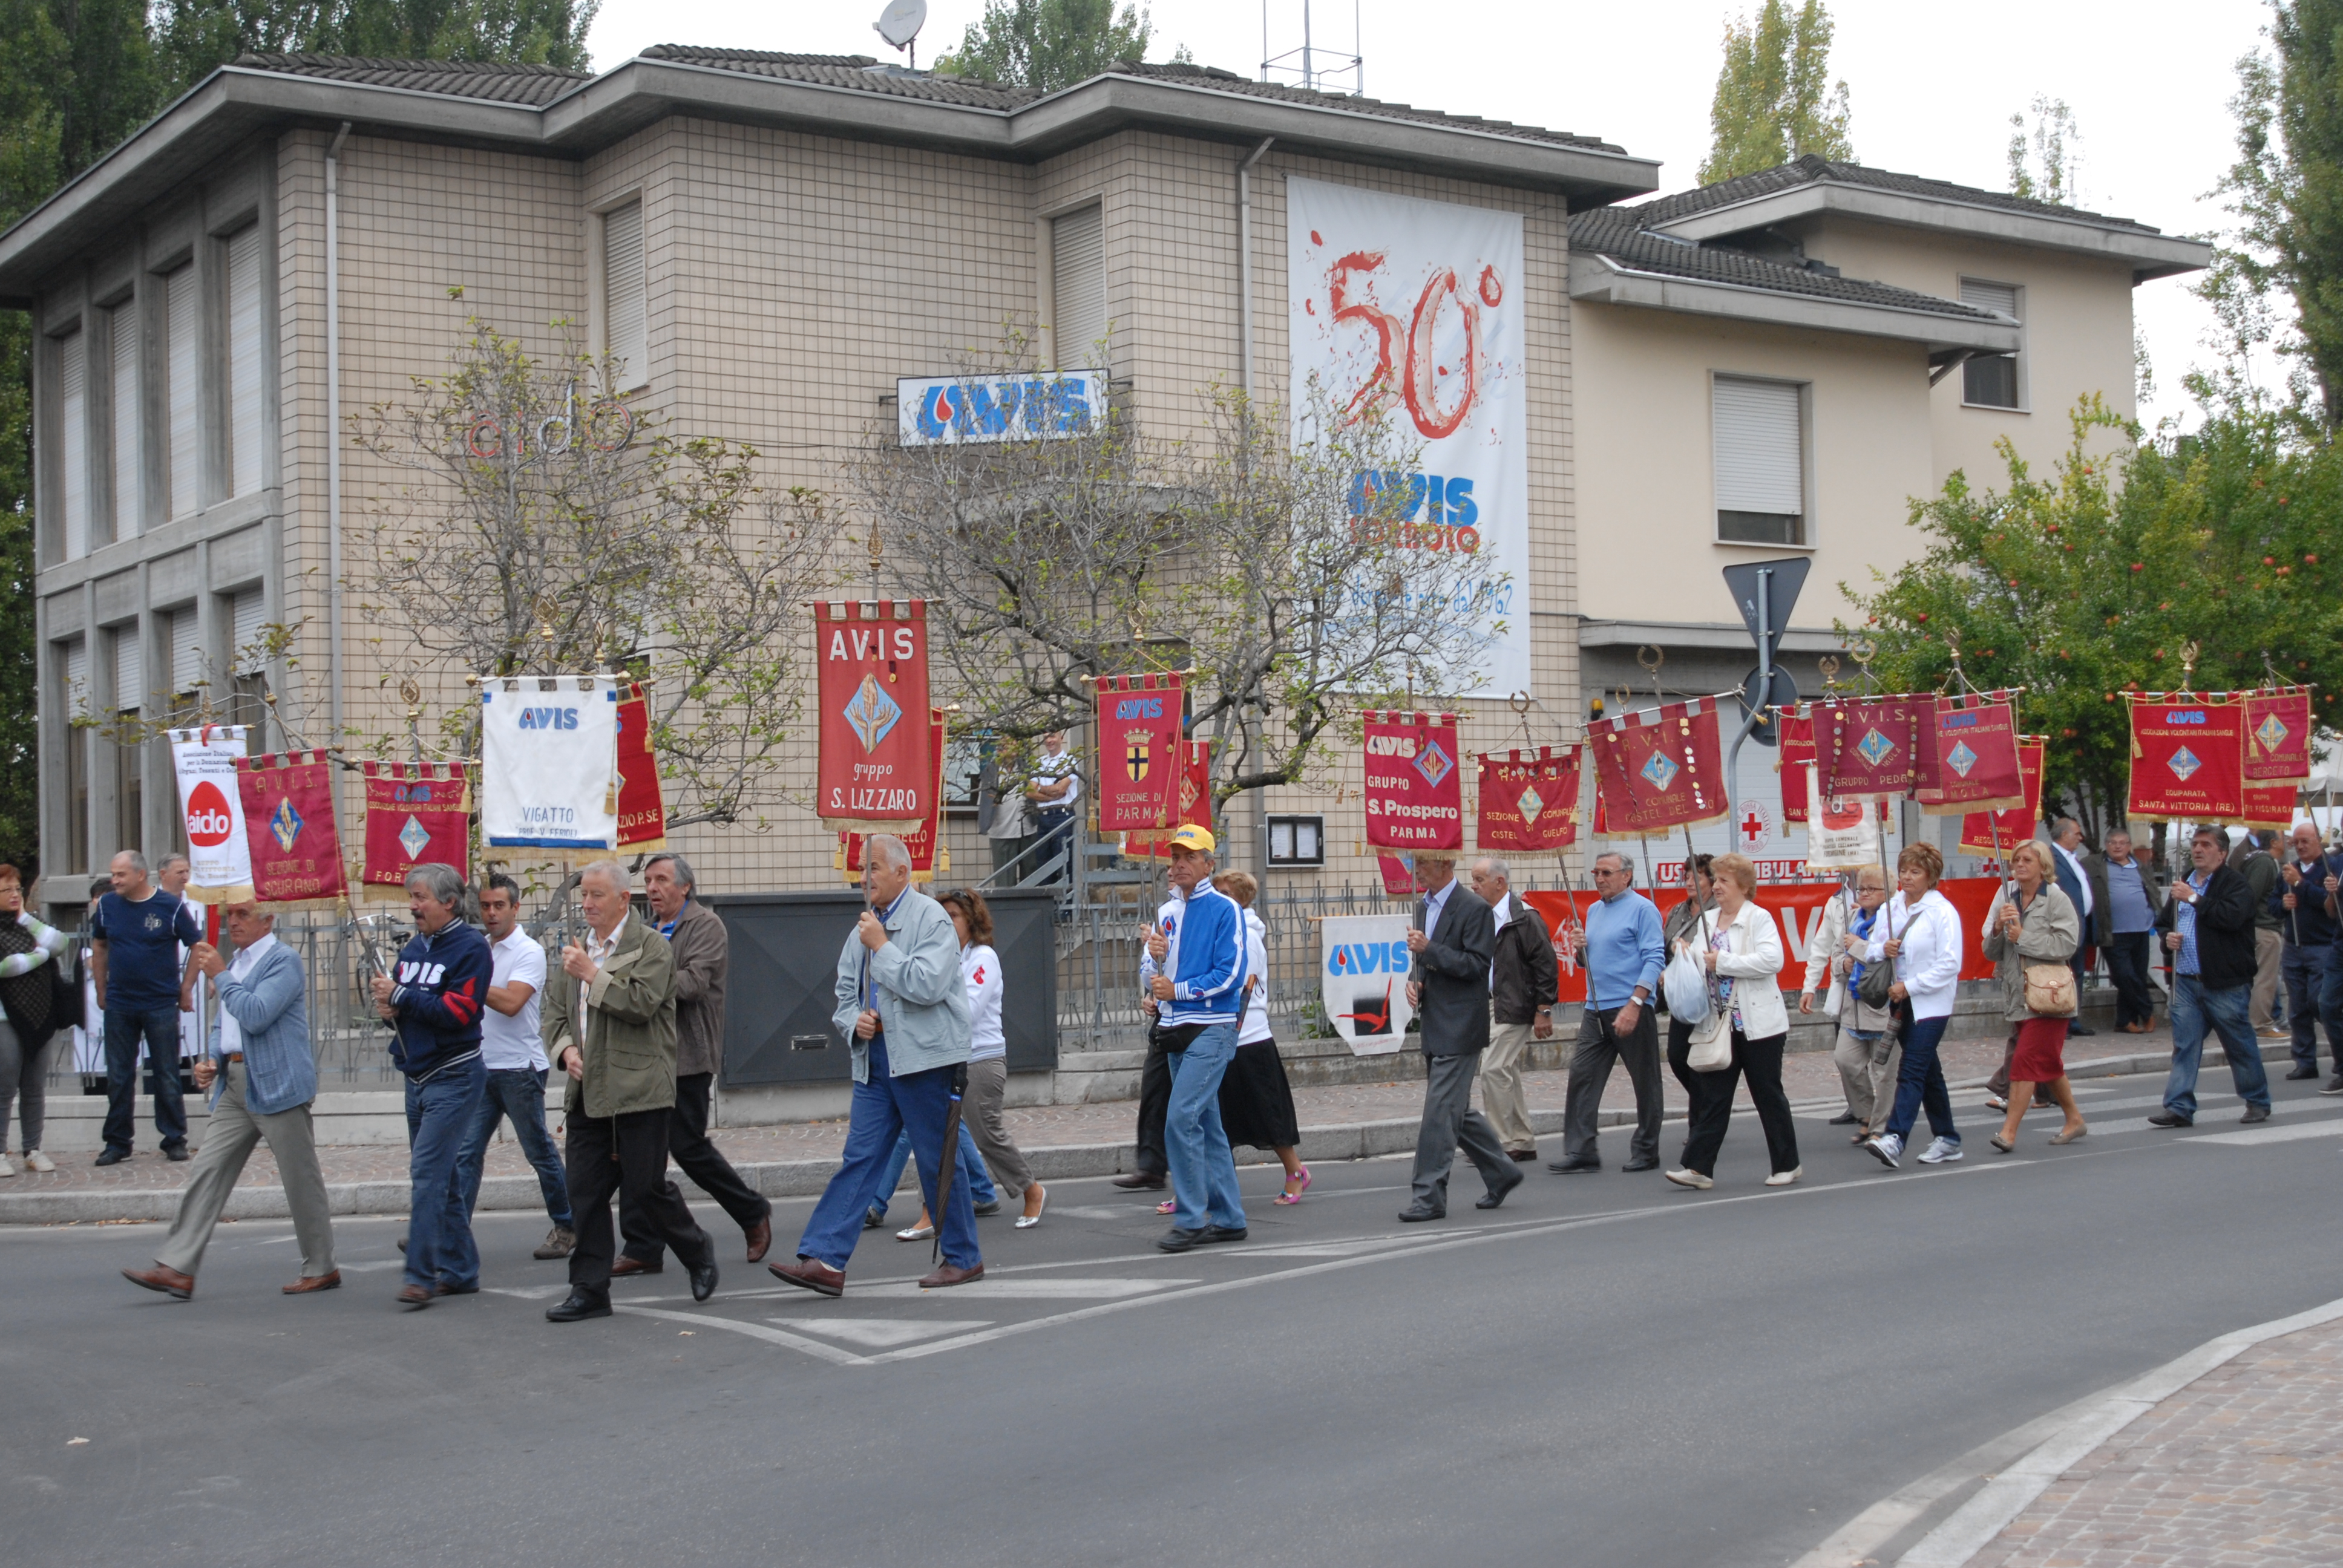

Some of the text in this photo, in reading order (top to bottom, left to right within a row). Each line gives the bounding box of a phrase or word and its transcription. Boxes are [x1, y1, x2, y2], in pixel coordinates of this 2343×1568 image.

[1330, 247, 1504, 439] 50°
[916, 377, 1091, 439] AVIS
[1347, 468, 1478, 528] AVIS
[1453, 579, 1472, 613] dal
[829, 628, 914, 661] AVIS
[1116, 698, 1163, 719] AVIS
[519, 707, 578, 730] AVIS
[1942, 713, 1977, 728] AVIS
[2166, 711, 2206, 724] AVIS
[1970, 725, 1990, 734] ITALIANI
[1367, 735, 1417, 759] AVIS
[1881, 747, 1902, 768] IMOLA
[2270, 753, 2304, 762] COMUNALE
[853, 763, 893, 782] gruppo
[1835, 773, 1927, 787] GRUPPO PEDANA
[2253, 766, 2290, 778] BERCETO
[1368, 776, 1409, 791] GRUPPO
[831, 787, 916, 810] S. LAZZARO
[1116, 792, 1161, 803] SEZIONE DI
[1645, 792, 1686, 807] COMUNALE
[1944, 786, 1989, 800] IMOLA
[522, 806, 574, 823] VIGATTO
[1116, 806, 1161, 820] PARMA
[1368, 799, 1458, 820] S. Prospero
[1487, 806, 1573, 822] SEZIONE COMUNALE
[1668, 804, 1689, 817] DEL
[2138, 800, 2235, 813] SANTA VITTORIA (RE)
[2255, 805, 2292, 814] FISSIRAGA
[188, 808, 229, 834] aido
[1391, 826, 1437, 839] PARMA
[1492, 827, 1568, 840] CASTEL GUELFO
[1973, 835, 2009, 846] REGGILO
[267, 859, 315, 875] SEZIONE DI
[264, 878, 321, 897] SCURANO
[1328, 941, 1409, 976] AVIS
